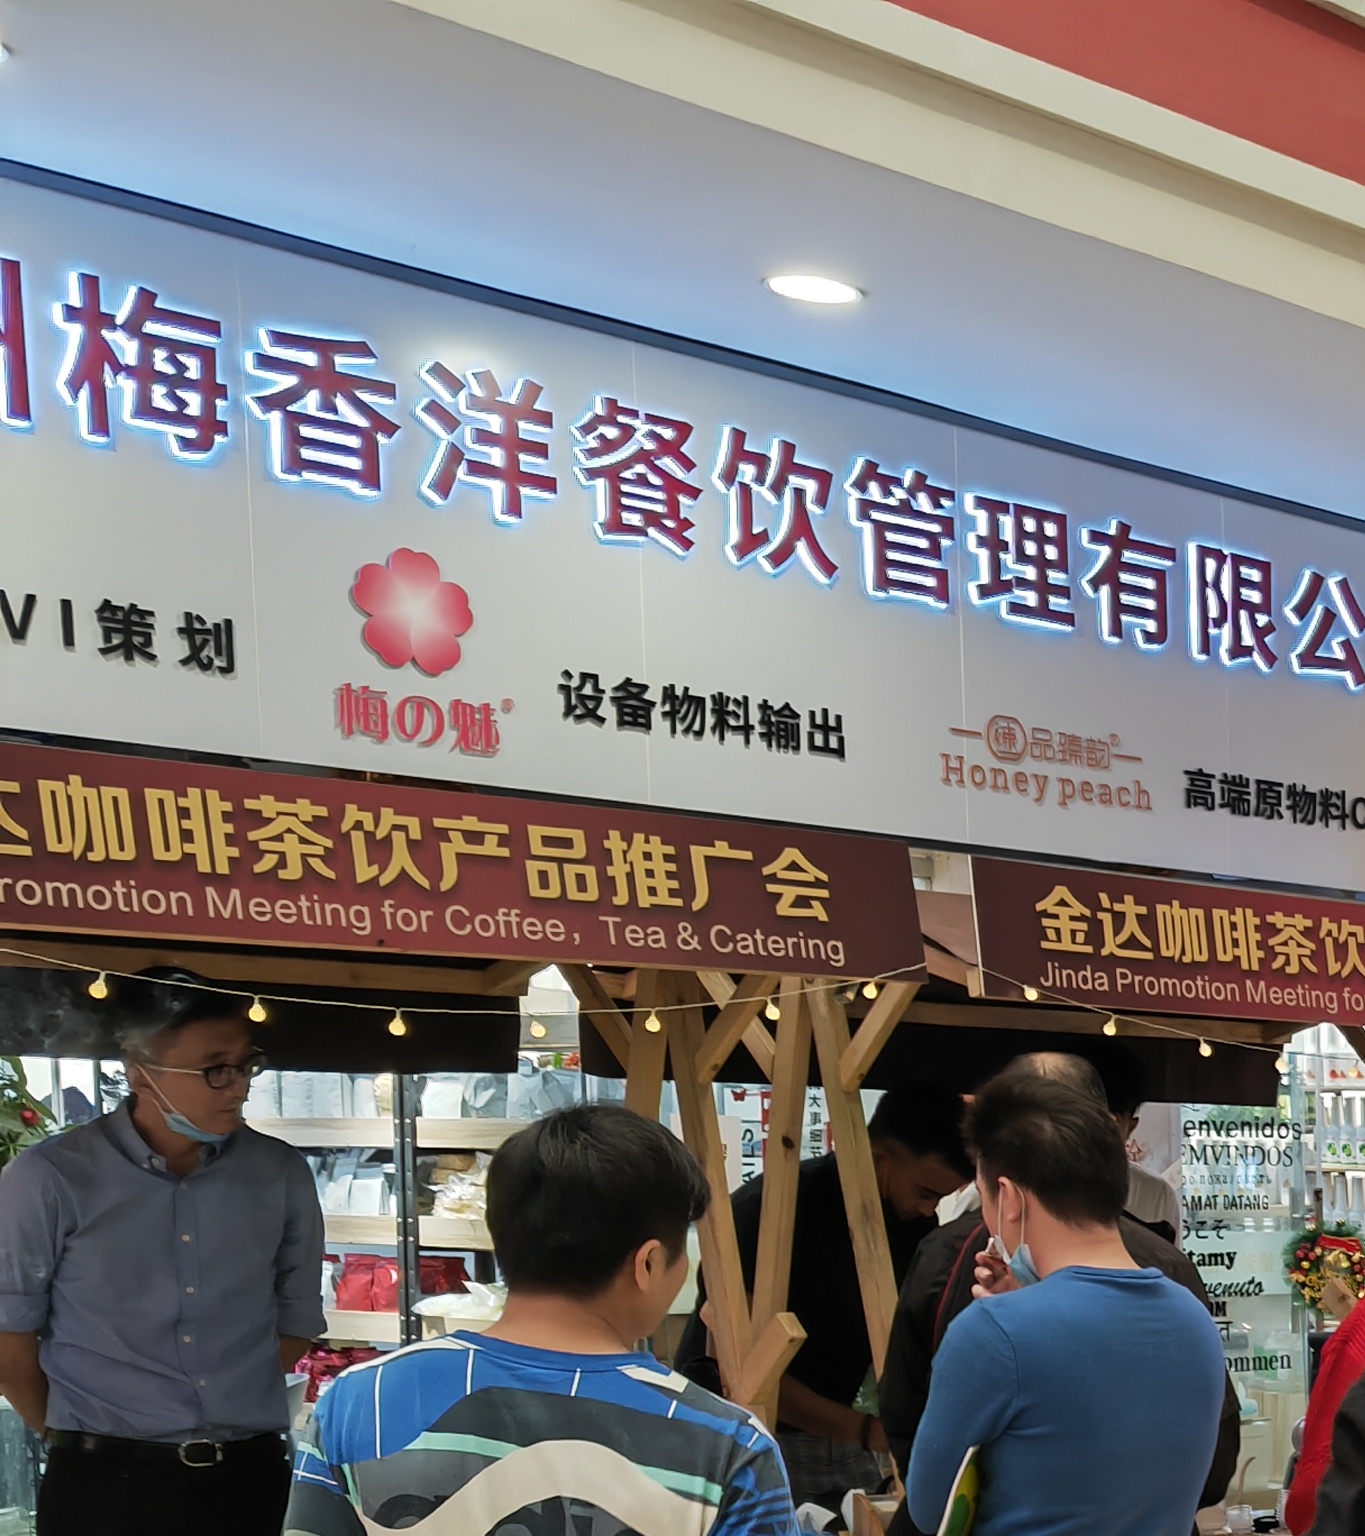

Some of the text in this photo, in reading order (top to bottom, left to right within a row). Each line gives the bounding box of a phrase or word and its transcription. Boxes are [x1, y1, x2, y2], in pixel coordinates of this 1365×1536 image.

[558, 669, 847, 760] 设备物料输出
[940, 752, 1153, 812] Honey peach
[205, 886, 372, 937] Meeting
[380, 899, 435, 935] for
[602, 915, 667, 951] Tea
[676, 920, 703, 952] &
[708, 922, 846, 968] Catering
[1039, 960, 1109, 993] Jinda
[1116, 966, 1240, 1003] Promotion
[1245, 979, 1338, 1015] Meeting
[1183, 1116, 1302, 1140] envenidos
